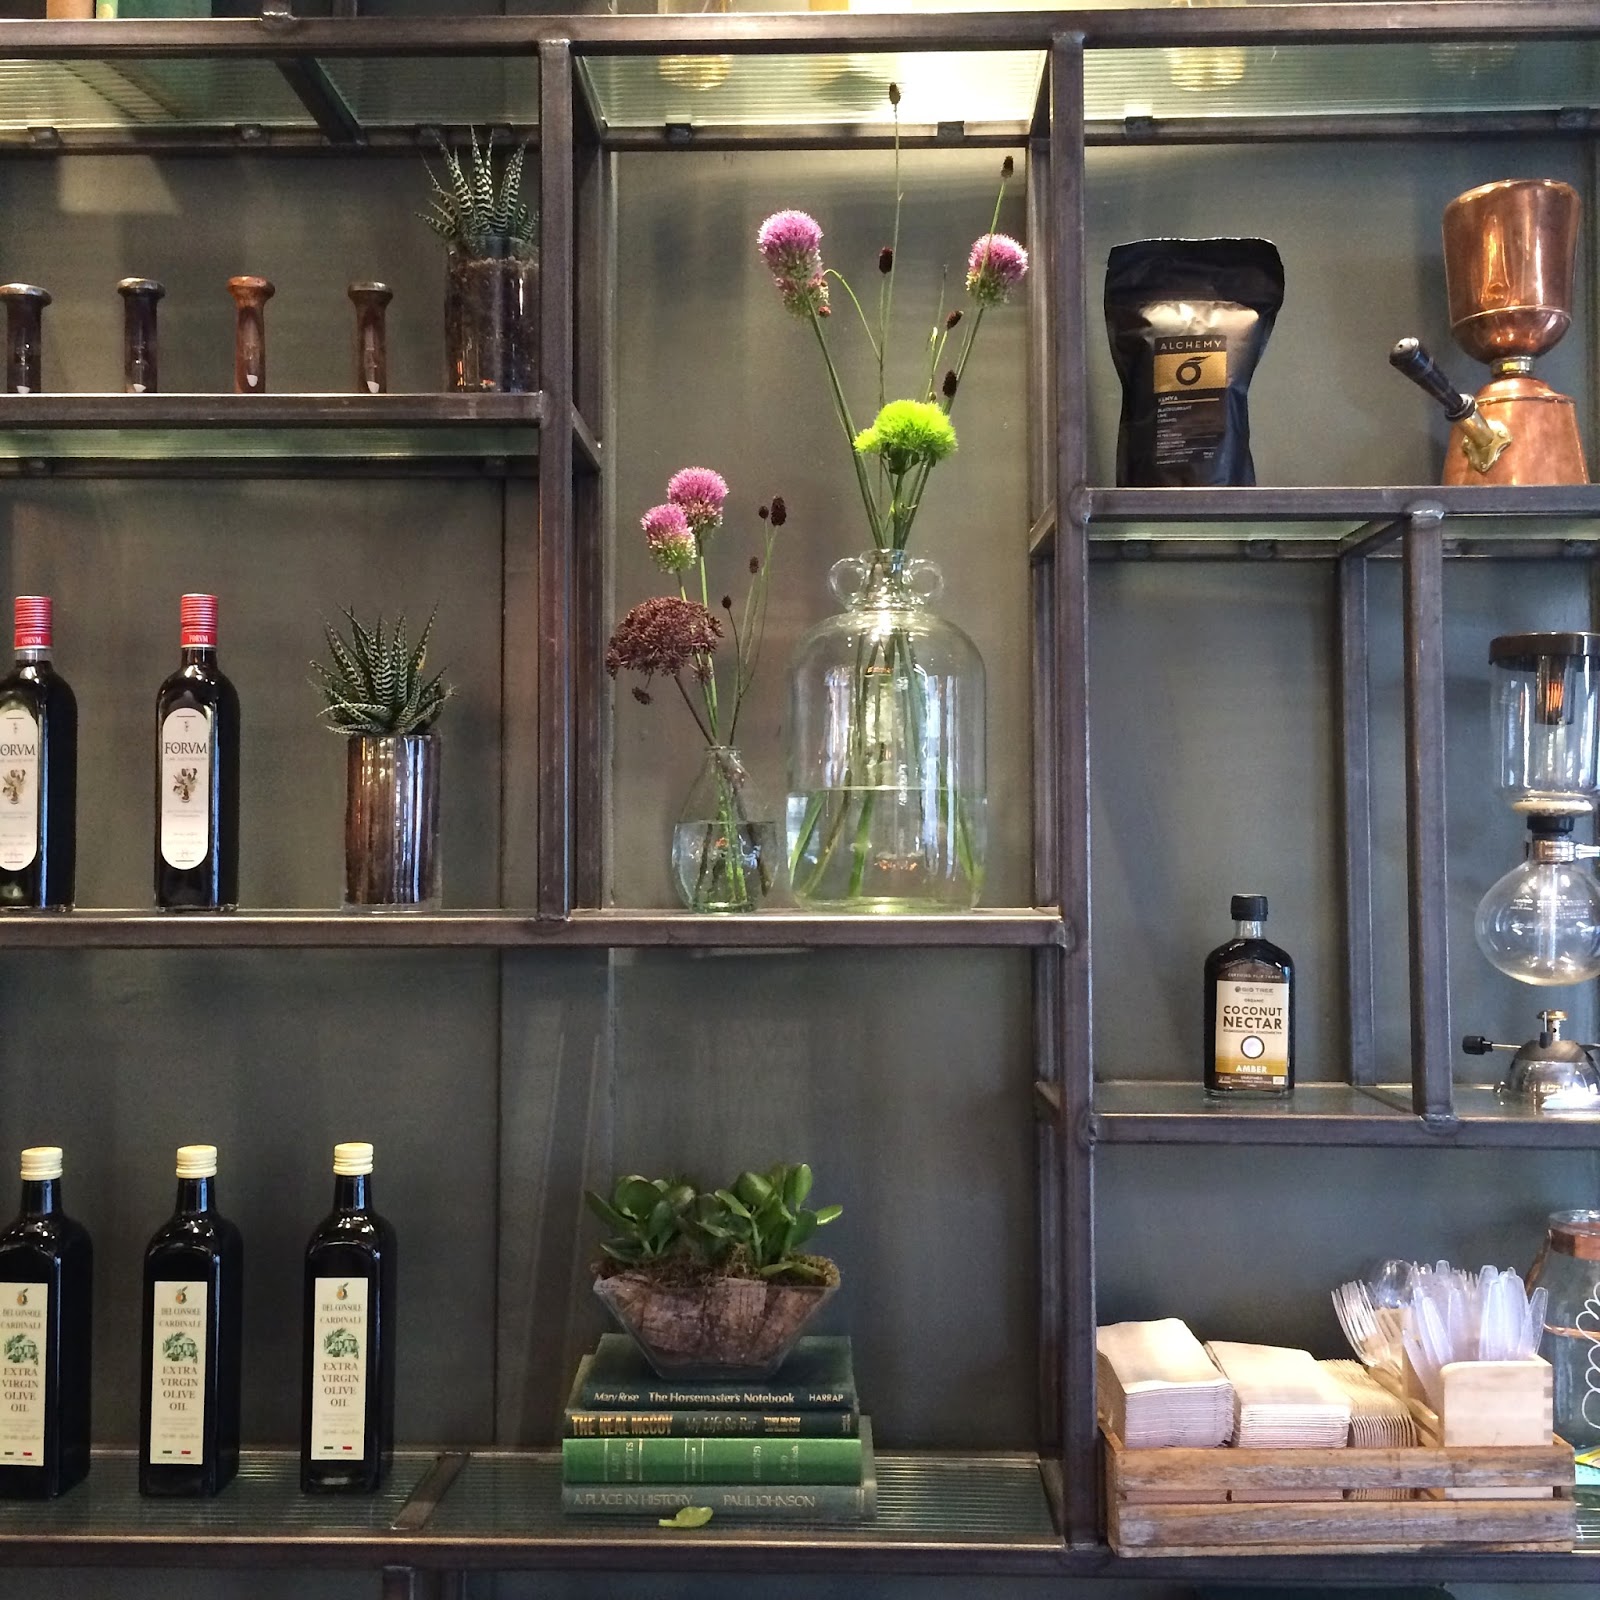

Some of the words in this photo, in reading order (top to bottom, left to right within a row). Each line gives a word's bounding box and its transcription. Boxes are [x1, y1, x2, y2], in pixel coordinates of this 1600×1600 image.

[1160, 340, 1222, 350] ALCHEMY
[0, 743, 36, 756] ORVM
[165, 741, 207, 754] FORVM
[1223, 1005, 1283, 1017] COCONUT
[1223, 1016, 1283, 1029] NECTAR
[1235, 1065, 1267, 1073] AMBER
[163, 1366, 197, 1375] EXTRA
[323, 1362, 358, 1371] EXTRA
[3, 1367, 38, 1376] EXTRA
[161, 1378, 198, 1387] VIRGIN
[321, 1374, 359, 1383] VIRGIN
[2, 1379, 39, 1388] VIRGIN
[163, 1390, 196, 1399] OLIVE
[324, 1386, 356, 1395] OLIVE
[4, 1392, 36, 1401] OLIVE
[594, 1392, 618, 1403] Mary
[619, 1392, 640, 1401] Rose
[648, 1392, 668, 1402] The
[670, 1392, 741, 1403] Horsemaster's
[744, 1392, 795, 1403] Notebook
[809, 1394, 843, 1402] HARRAP
[169, 1402, 188, 1411] OIL
[330, 1398, 350, 1407] OIL
[10, 1404, 29, 1412] OIL
[572, 1414, 596, 1435] THE
[599, 1415, 629, 1435] REAL
[684, 1417, 701, 1433] My
[703, 1416, 722, 1433] Life
[724, 1416, 737, 1431] So
[573, 1494, 583, 1504] A
[585, 1494, 623, 1505] PLACE
[625, 1494, 638, 1505] IN
[641, 1494, 693, 1505] HISTORY
[723, 1494, 755, 1506] PAUL
[755, 1495, 816, 1507] JOHNSON
